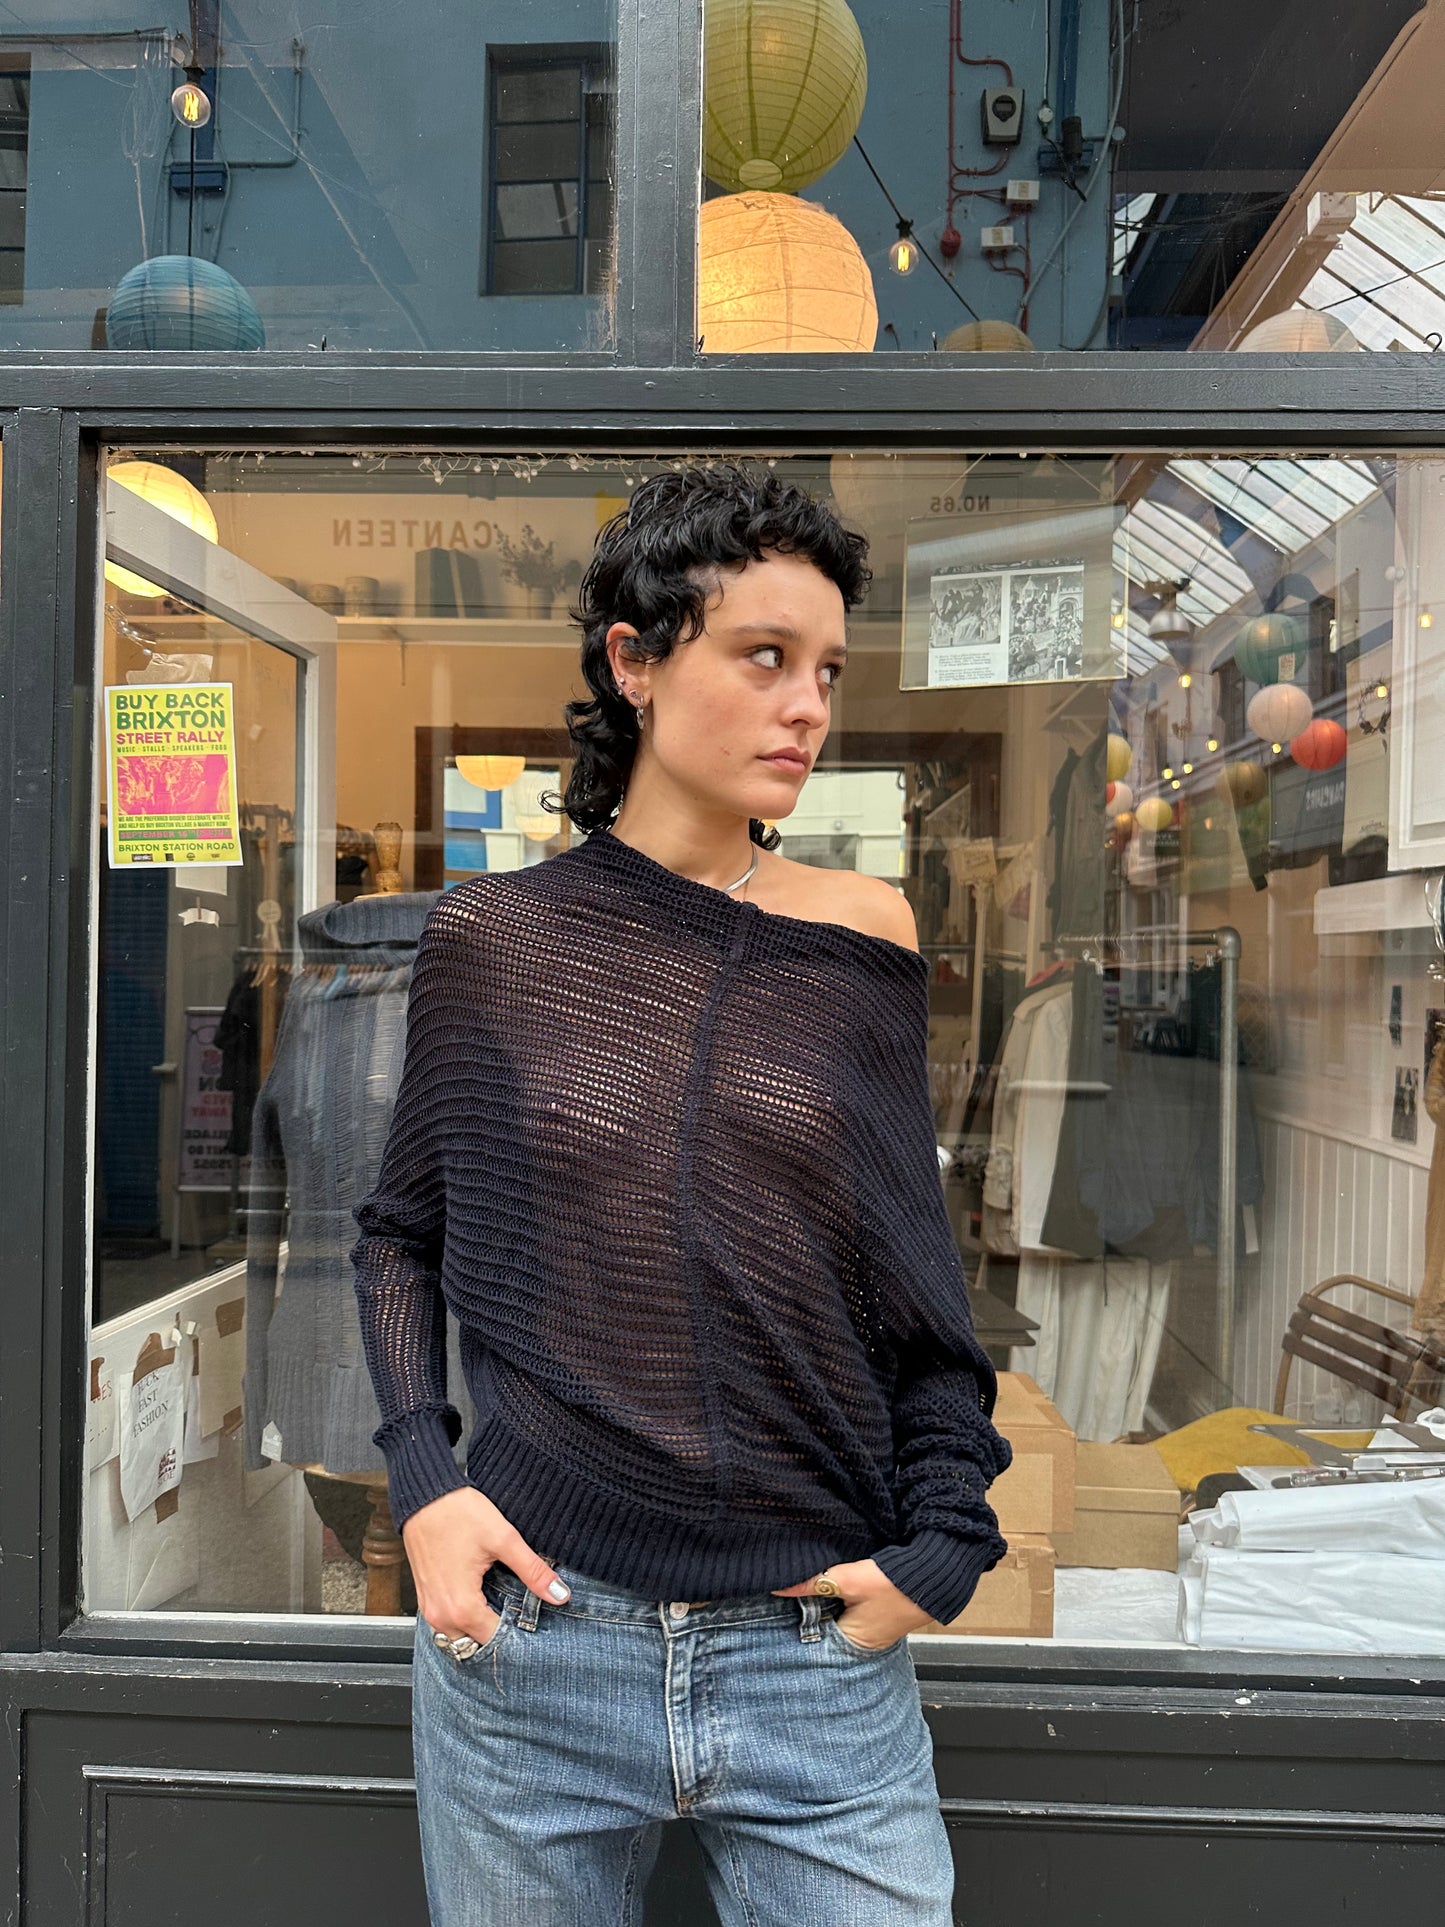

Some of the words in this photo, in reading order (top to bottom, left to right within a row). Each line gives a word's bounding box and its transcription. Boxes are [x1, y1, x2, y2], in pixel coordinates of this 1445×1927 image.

[116, 695, 158, 710] BUY
[165, 692, 224, 709] BACK
[116, 710, 226, 730] BRIXTON
[116, 732, 172, 745] STREET
[177, 730, 225, 743] RALLY
[120, 831, 174, 839] SEPTEMBER
[118, 844, 160, 852] BRIXTON
[163, 843, 204, 851] STATION
[206, 842, 234, 850] ROAD
[138, 1390, 158, 1413] FAST
[132, 1400, 168, 1438] FASHION
